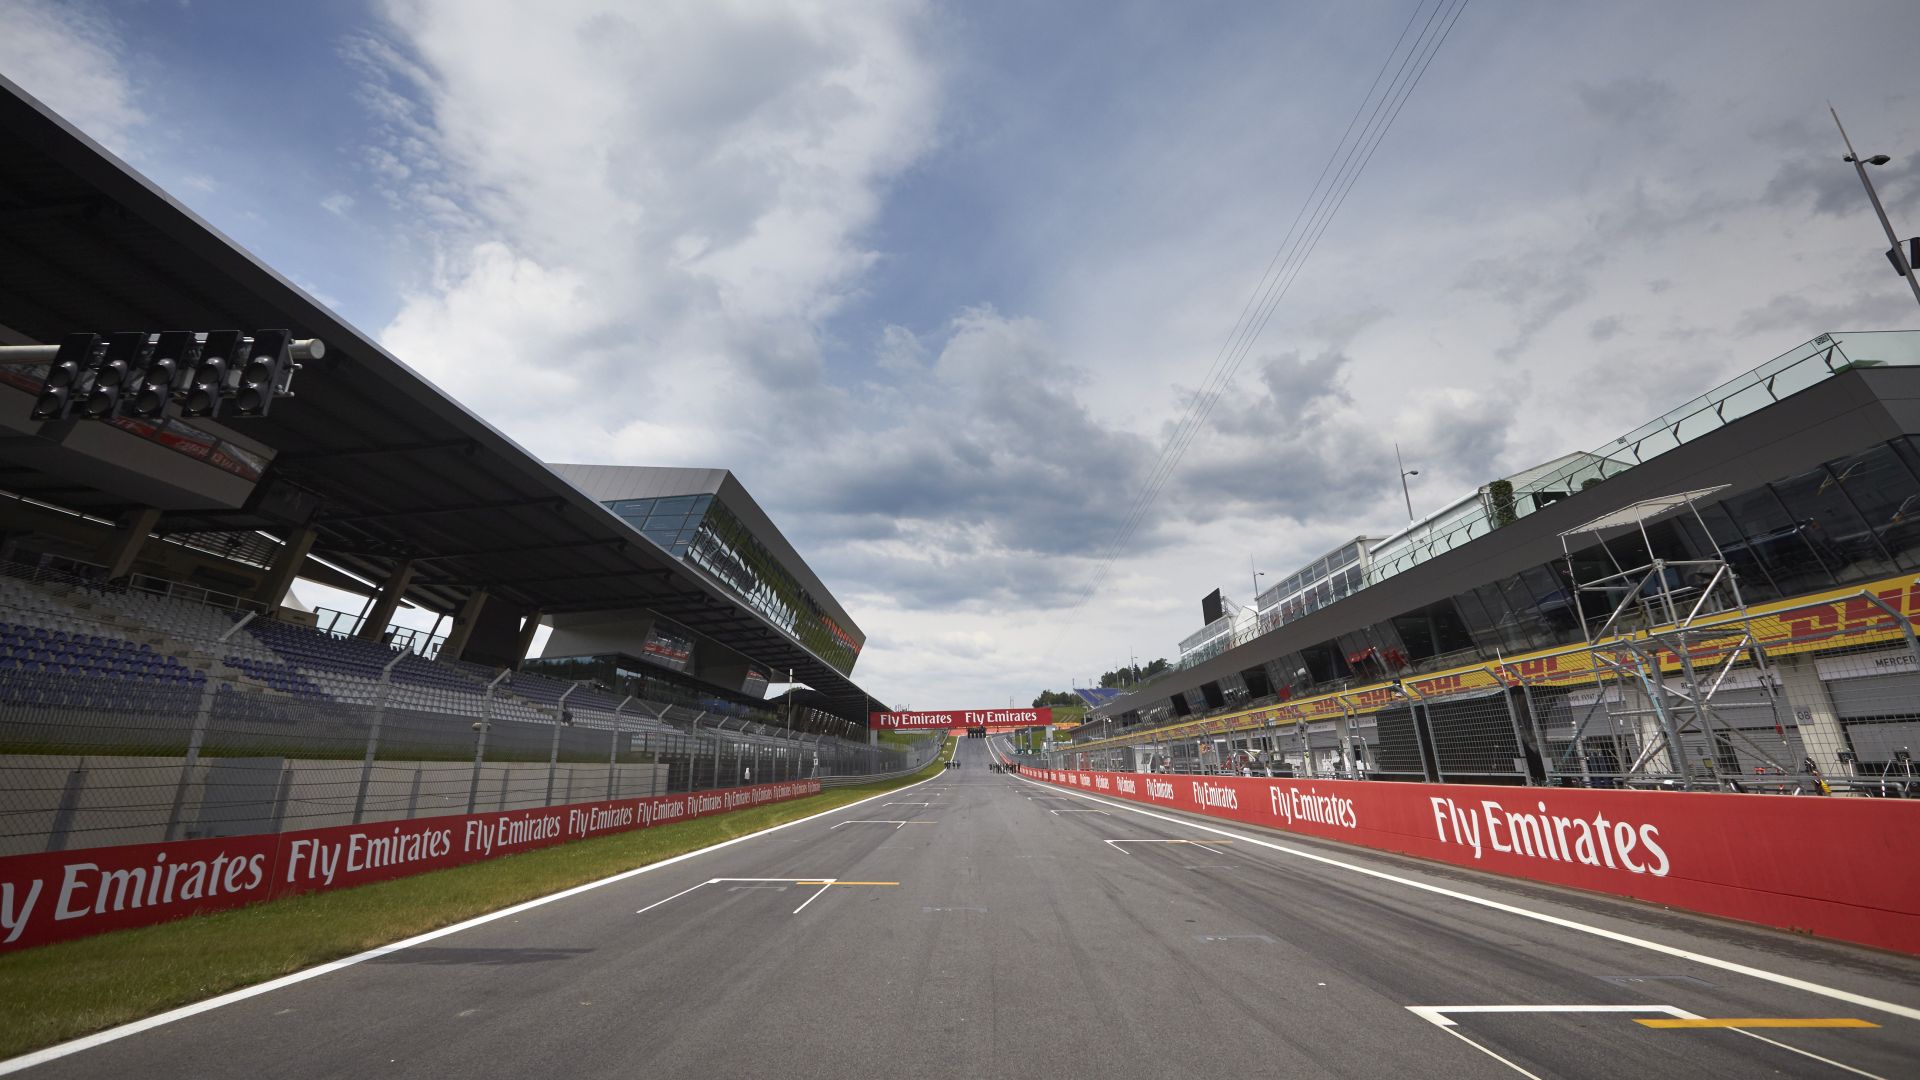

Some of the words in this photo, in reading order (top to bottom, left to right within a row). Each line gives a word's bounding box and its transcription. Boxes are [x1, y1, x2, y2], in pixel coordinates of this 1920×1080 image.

[1875, 655, 1918, 667] MERCED
[880, 714, 900, 728] Fly
[902, 712, 952, 725] Emirates
[965, 712, 985, 725] Fly
[987, 710, 1037, 723] Emirates
[1797, 711, 1811, 720] 08
[725, 792, 733, 810] Fly
[732, 790, 750, 806] Emirates
[1146, 779, 1155, 800] Fly
[1153, 778, 1174, 800] Emirates
[1192, 782, 1205, 810] Fly
[1203, 781, 1238, 810] Emirates
[637, 802, 653, 827] Fly
[653, 799, 684, 821] Emirates
[687, 796, 699, 817] Fly
[699, 793, 722, 812] Emirates
[1270, 786, 1292, 825] Fly
[1290, 787, 1356, 828] Emirates
[464, 820, 495, 856] Fly
[497, 813, 561, 847] Emirates
[568, 809, 589, 837] Fly
[590, 804, 633, 832] Emirates
[1430, 796, 1482, 859] Fly
[1481, 800, 1670, 877] Emirates
[287, 838, 342, 886] Fly
[346, 826, 451, 872] Emirates
[55, 851, 265, 921] Emirates
